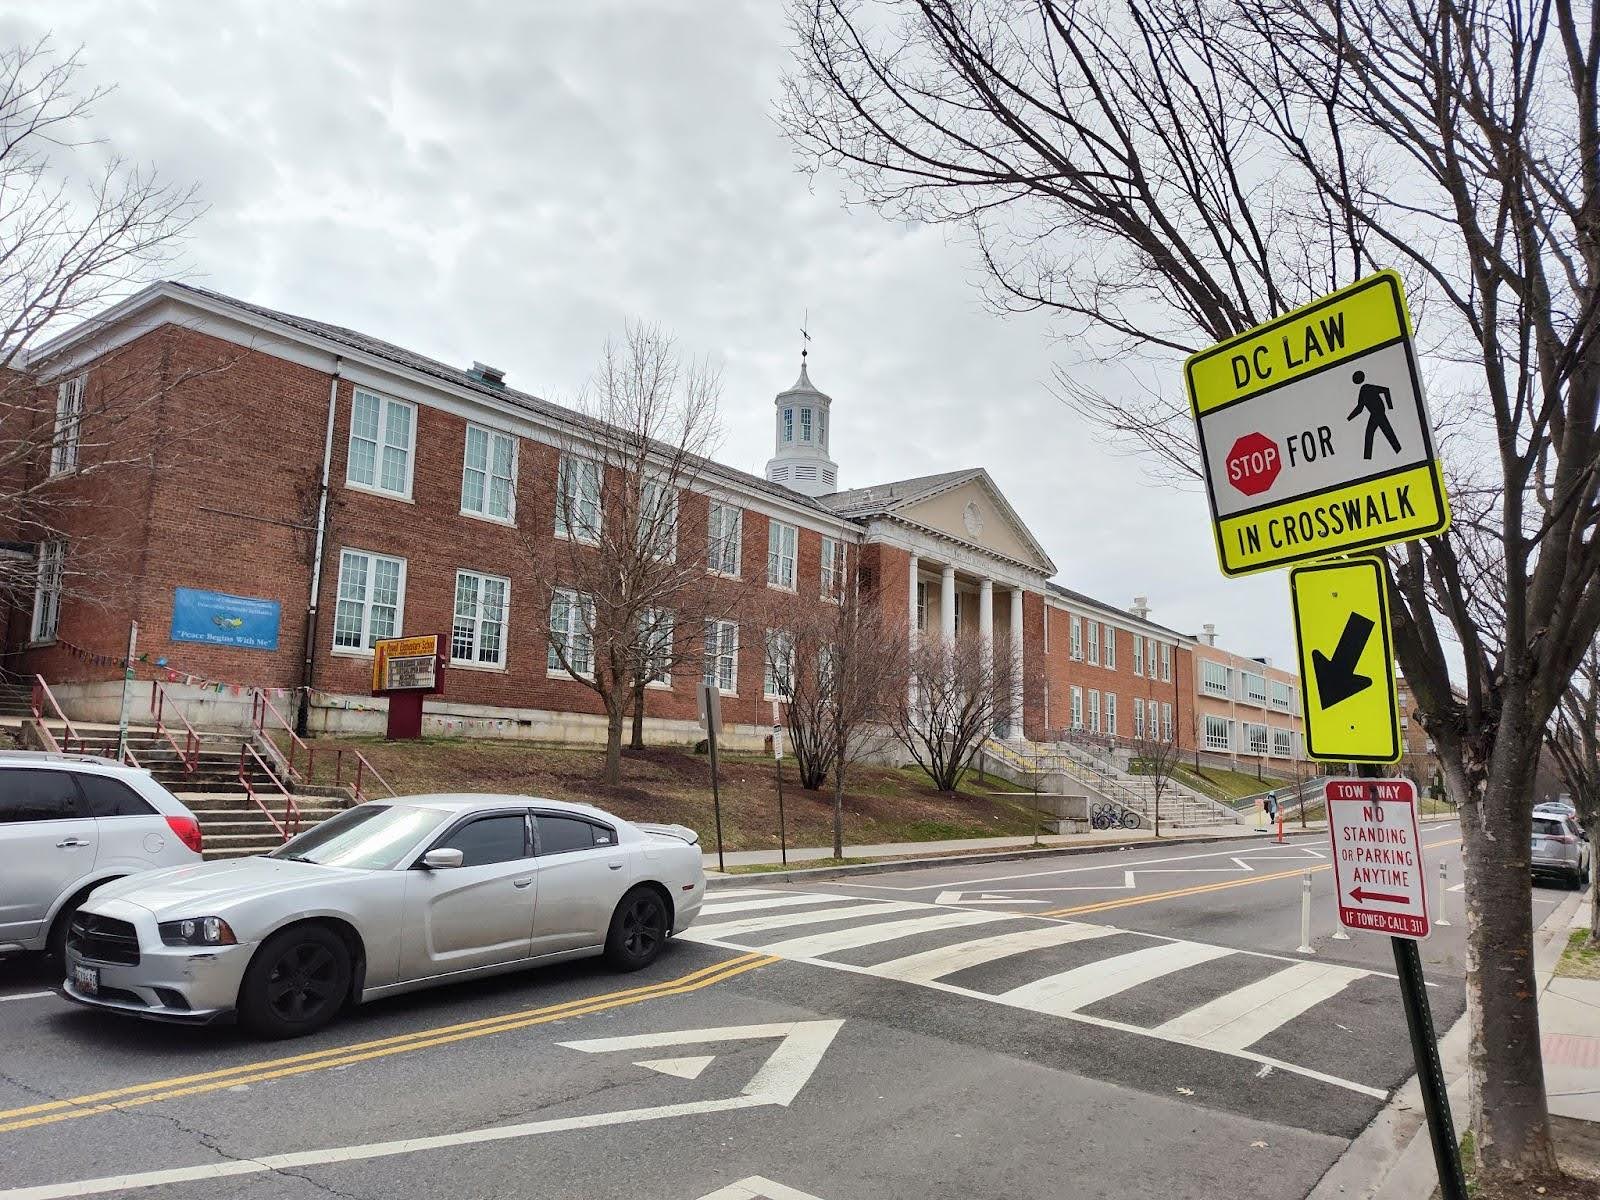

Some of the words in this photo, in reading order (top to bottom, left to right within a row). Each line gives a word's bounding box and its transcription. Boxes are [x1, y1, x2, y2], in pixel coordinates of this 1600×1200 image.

[1231, 345, 1272, 389] DC
[1282, 312, 1346, 369] LAW
[1230, 447, 1277, 480] STOP
[1286, 425, 1335, 467] FOR
[1237, 525, 1262, 556] IN
[1268, 485, 1416, 549] CROSSWALK
[206, 633, 234, 643] Begins
[236, 636, 255, 645] With
[1338, 785, 1363, 798] TOW
[1369, 785, 1400, 799] WAY
[1363, 806, 1384, 823] NO
[1343, 826, 1406, 844] STANDING
[1342, 849, 1353, 861] OR
[1357, 847, 1413, 866] PARKING
[1353, 867, 1410, 887] ANYTIME
[1346, 911, 1353, 924] IF
[1357, 913, 1384, 928] TOWED
[1387, 916, 1409, 932] CALL
[1411, 919, 1423, 933] 311
